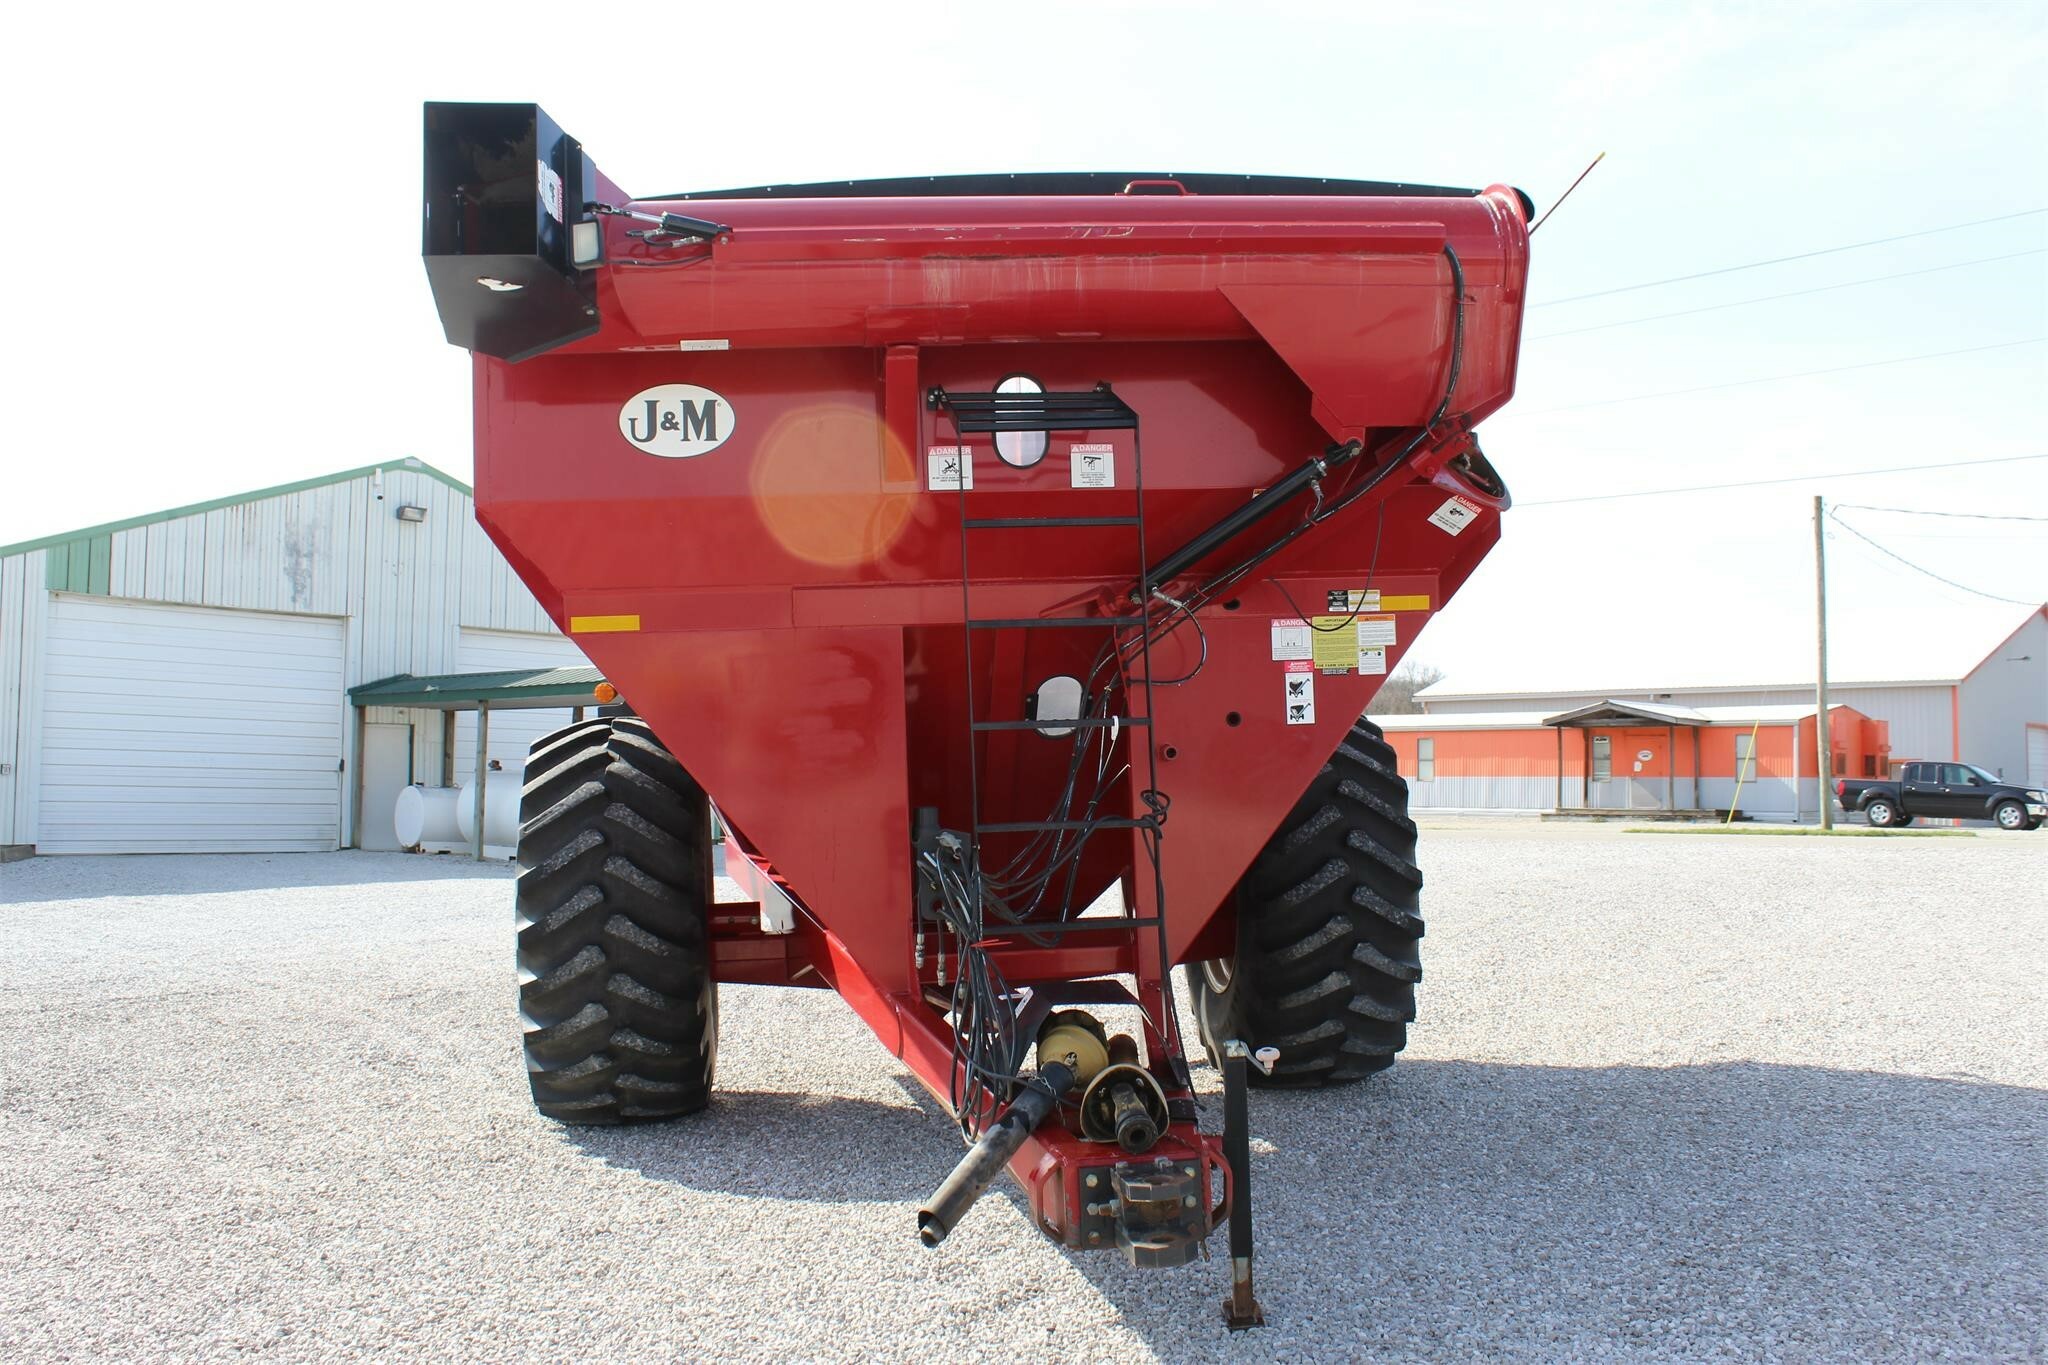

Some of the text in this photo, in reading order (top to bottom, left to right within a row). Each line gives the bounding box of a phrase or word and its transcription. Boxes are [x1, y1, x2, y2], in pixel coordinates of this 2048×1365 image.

[628, 399, 719, 443] J&M
[1080, 444, 1113, 452] DANGER
[1458, 497, 1482, 514] DANGER
